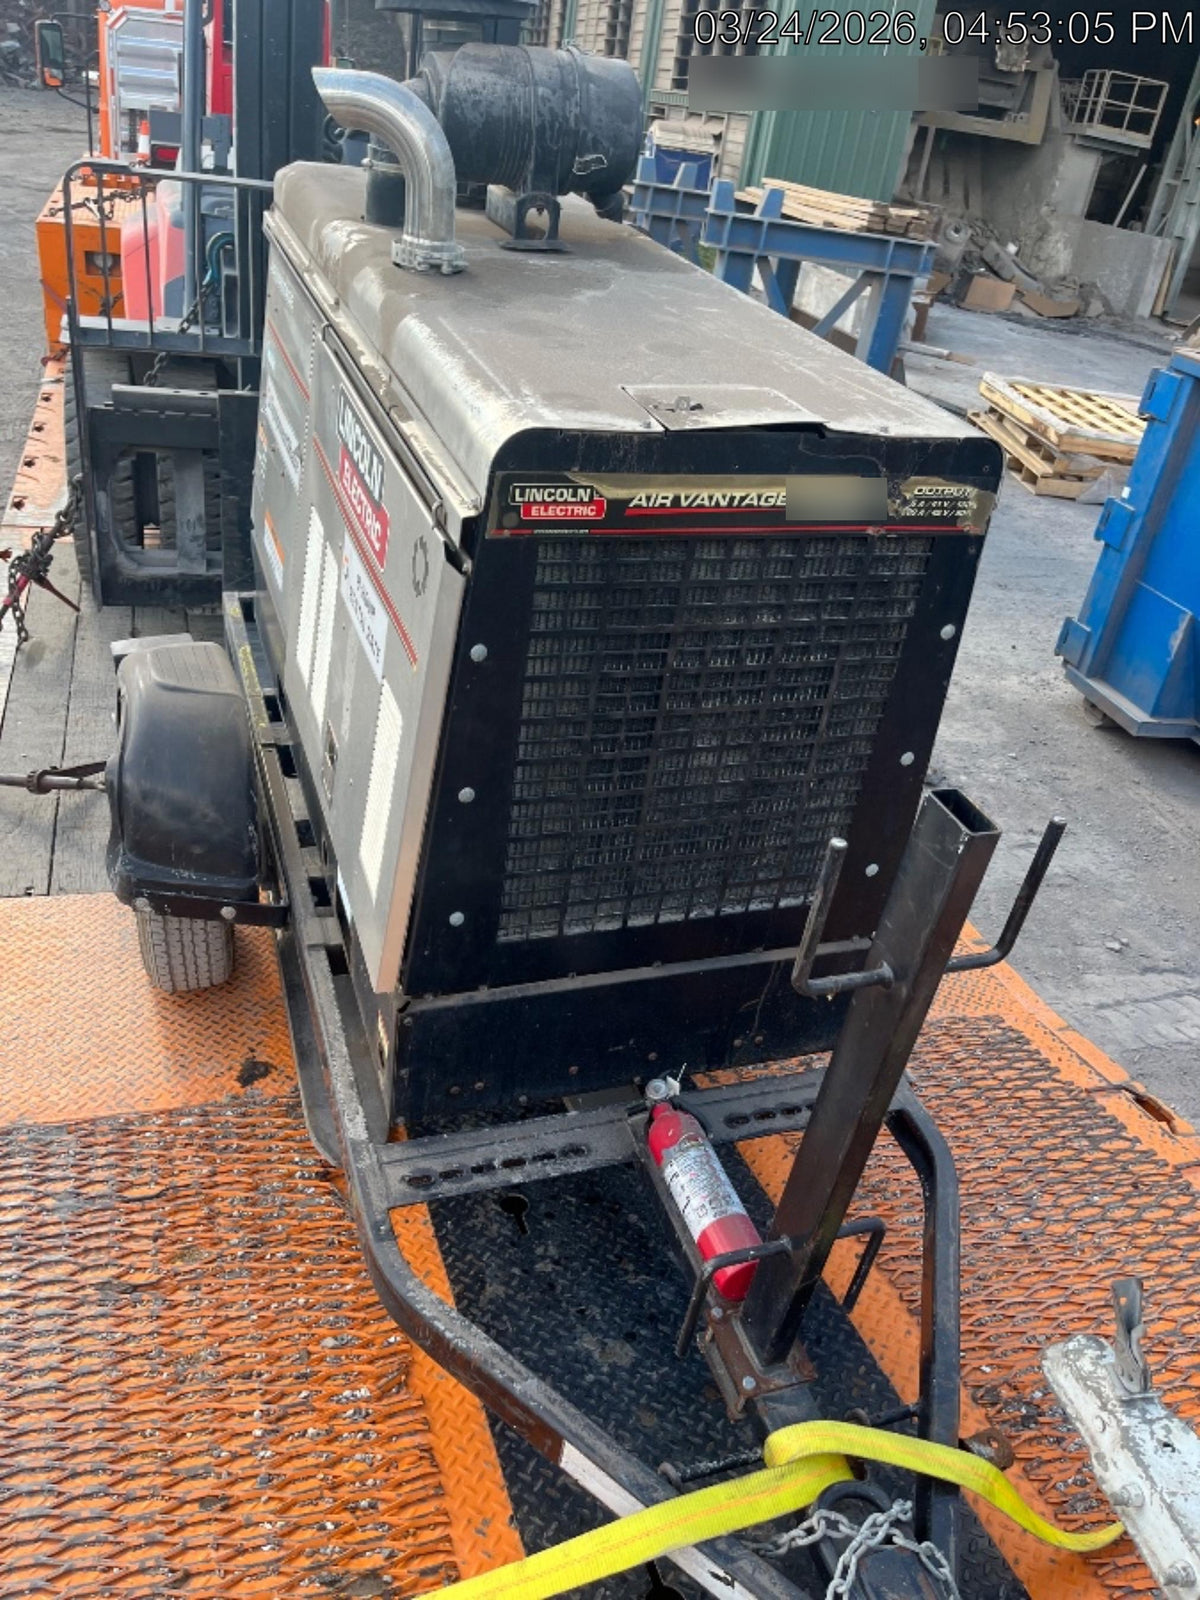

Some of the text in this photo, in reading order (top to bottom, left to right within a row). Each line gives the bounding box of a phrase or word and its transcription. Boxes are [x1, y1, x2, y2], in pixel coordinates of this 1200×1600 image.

[340, 402, 383, 501] LINCOLN
[514, 487, 591, 502] LINCOLN
[629, 492, 787, 508] AIR VANTAGE
[343, 459, 382, 551] ELECTRIC
[530, 505, 597, 517] ELECTRIC
